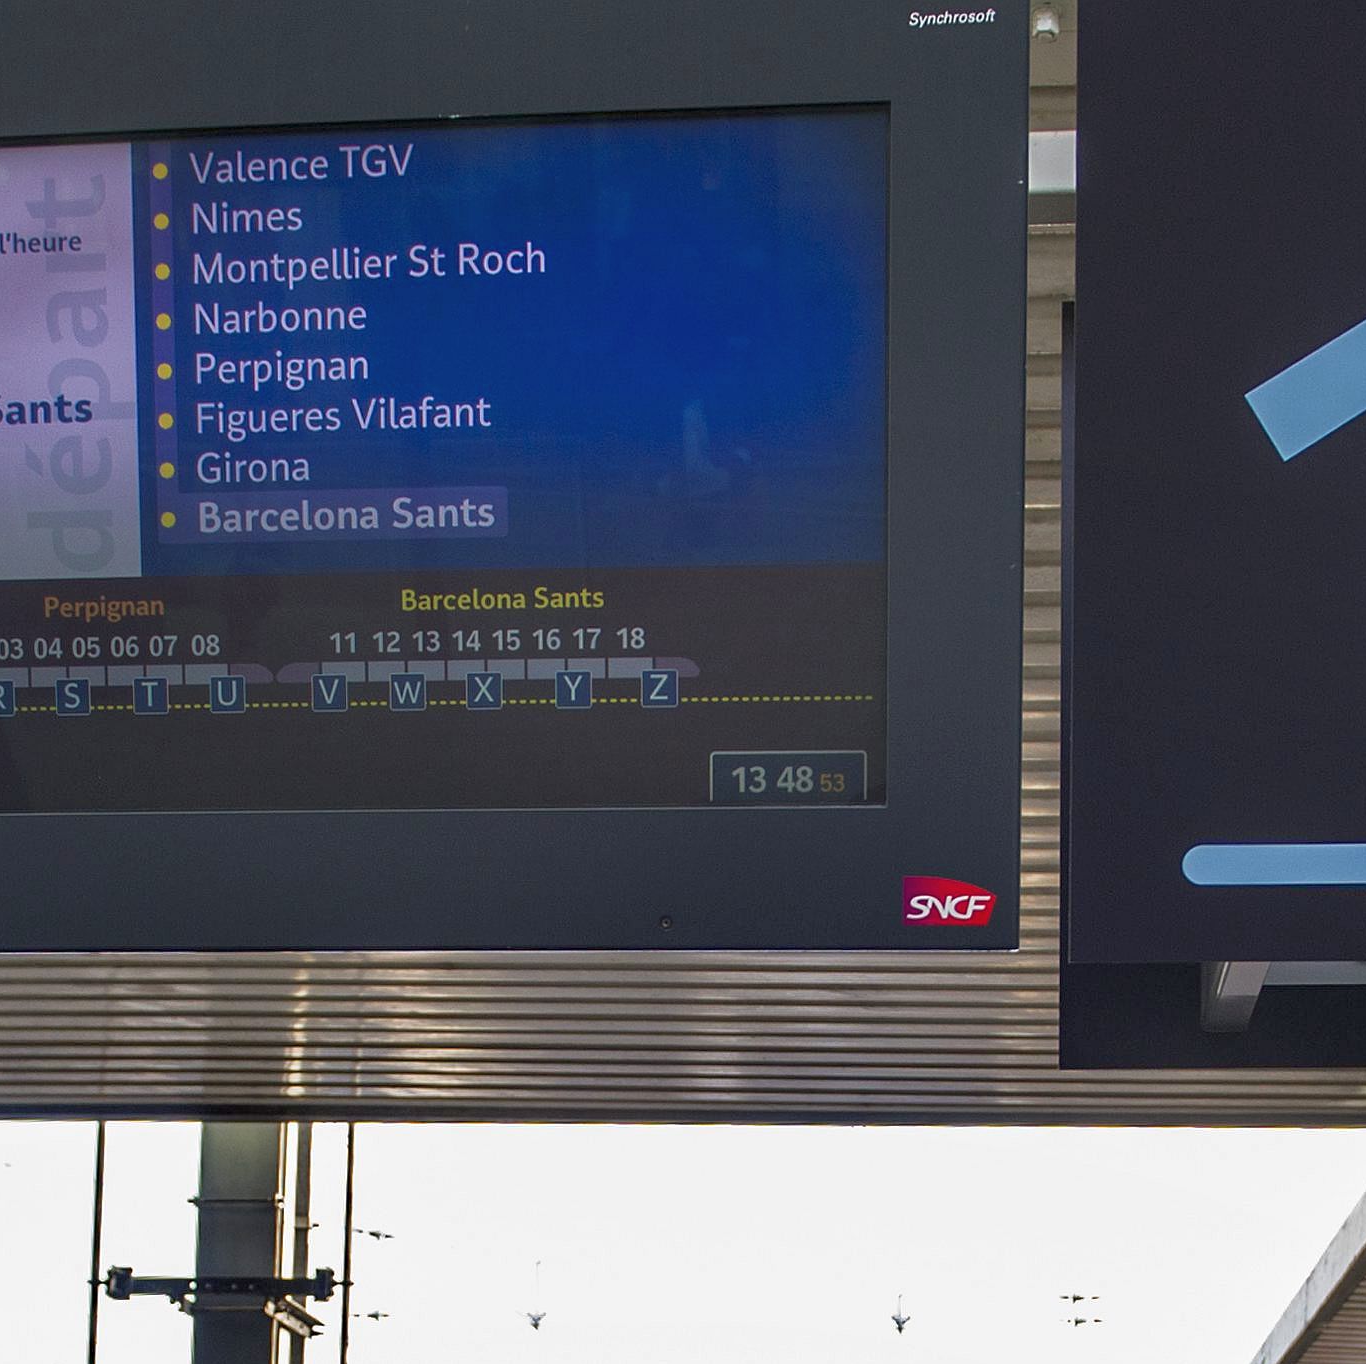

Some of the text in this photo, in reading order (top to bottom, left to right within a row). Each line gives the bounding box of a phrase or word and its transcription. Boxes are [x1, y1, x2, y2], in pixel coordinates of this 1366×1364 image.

[908, 8, 996, 28] Synchrosoft
[189, 143, 414, 184] Valence TGV
[192, 202, 303, 235] Nimes
[193, 241, 546, 290] Montpellier St Roch
[194, 301, 367, 335] Narbonne
[195, 350, 370, 392] Perpignan
[196, 396, 492, 443] Figueres Vilafant
[196, 451, 311, 484] Girona
[198, 496, 496, 534] Barcelona Sants
[43, 595, 165, 623] Perpignan
[401, 587, 605, 612] Barcelona Sants
[34, 638, 63, 659] 04
[72, 637, 101, 658] 05
[110, 636, 140, 658] 06
[148, 635, 178, 657] 07
[190, 634, 221, 656] 08
[329, 627, 645, 653] 11 12 13 14 15 16 17 18
[64, 683, 81, 709] S
[141, 682, 158, 707] T
[217, 680, 237, 706] U
[319, 674, 669, 704] V W X Y Z
[731, 766, 846, 793] 13 48 53
[906, 895, 991, 919] SNCF
